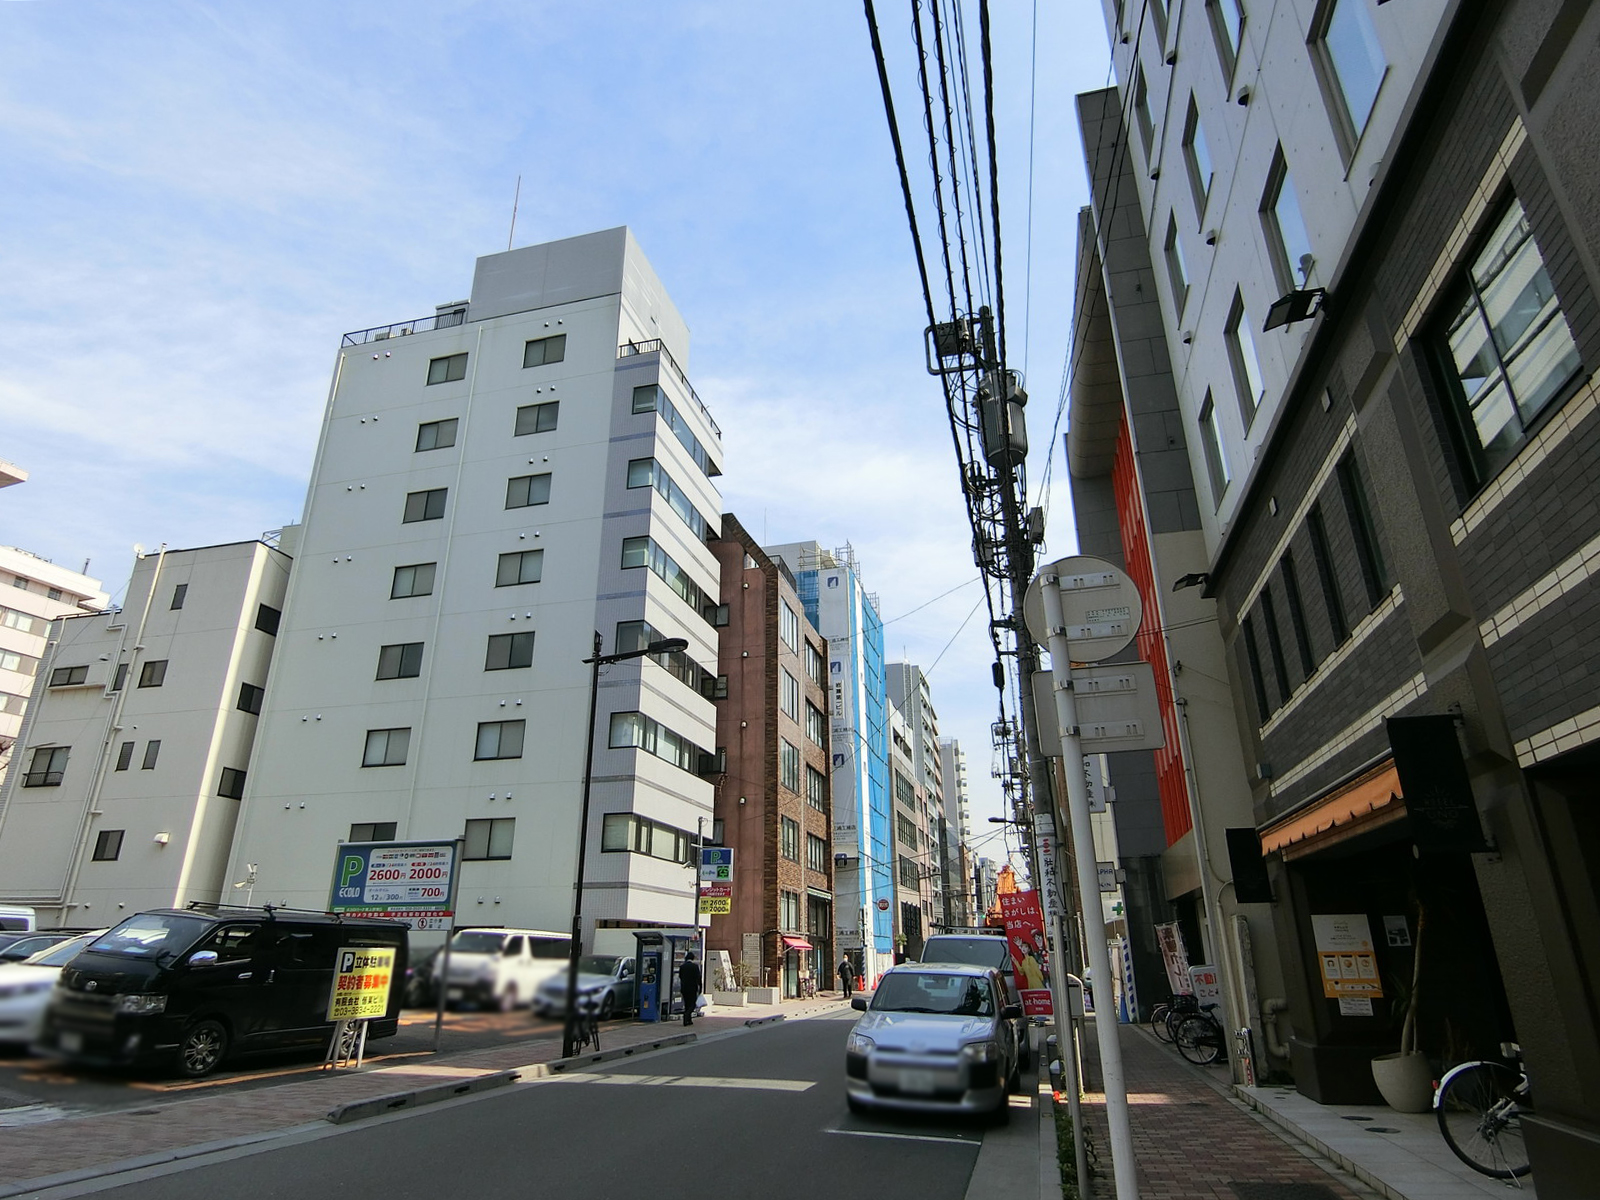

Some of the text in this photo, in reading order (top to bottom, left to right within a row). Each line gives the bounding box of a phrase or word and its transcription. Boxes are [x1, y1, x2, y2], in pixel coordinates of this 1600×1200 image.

[340, 855, 365, 887] P
[339, 887, 361, 898] ECOLO
[1001, 896, 1026, 906] 住まい
[1004, 906, 1040, 918] さがしは、
[342, 953, 354, 972] P
[337, 973, 389, 990] 契約者募集中
[1194, 972, 1217, 985] 不動
[1024, 997, 1051, 1006] at home
